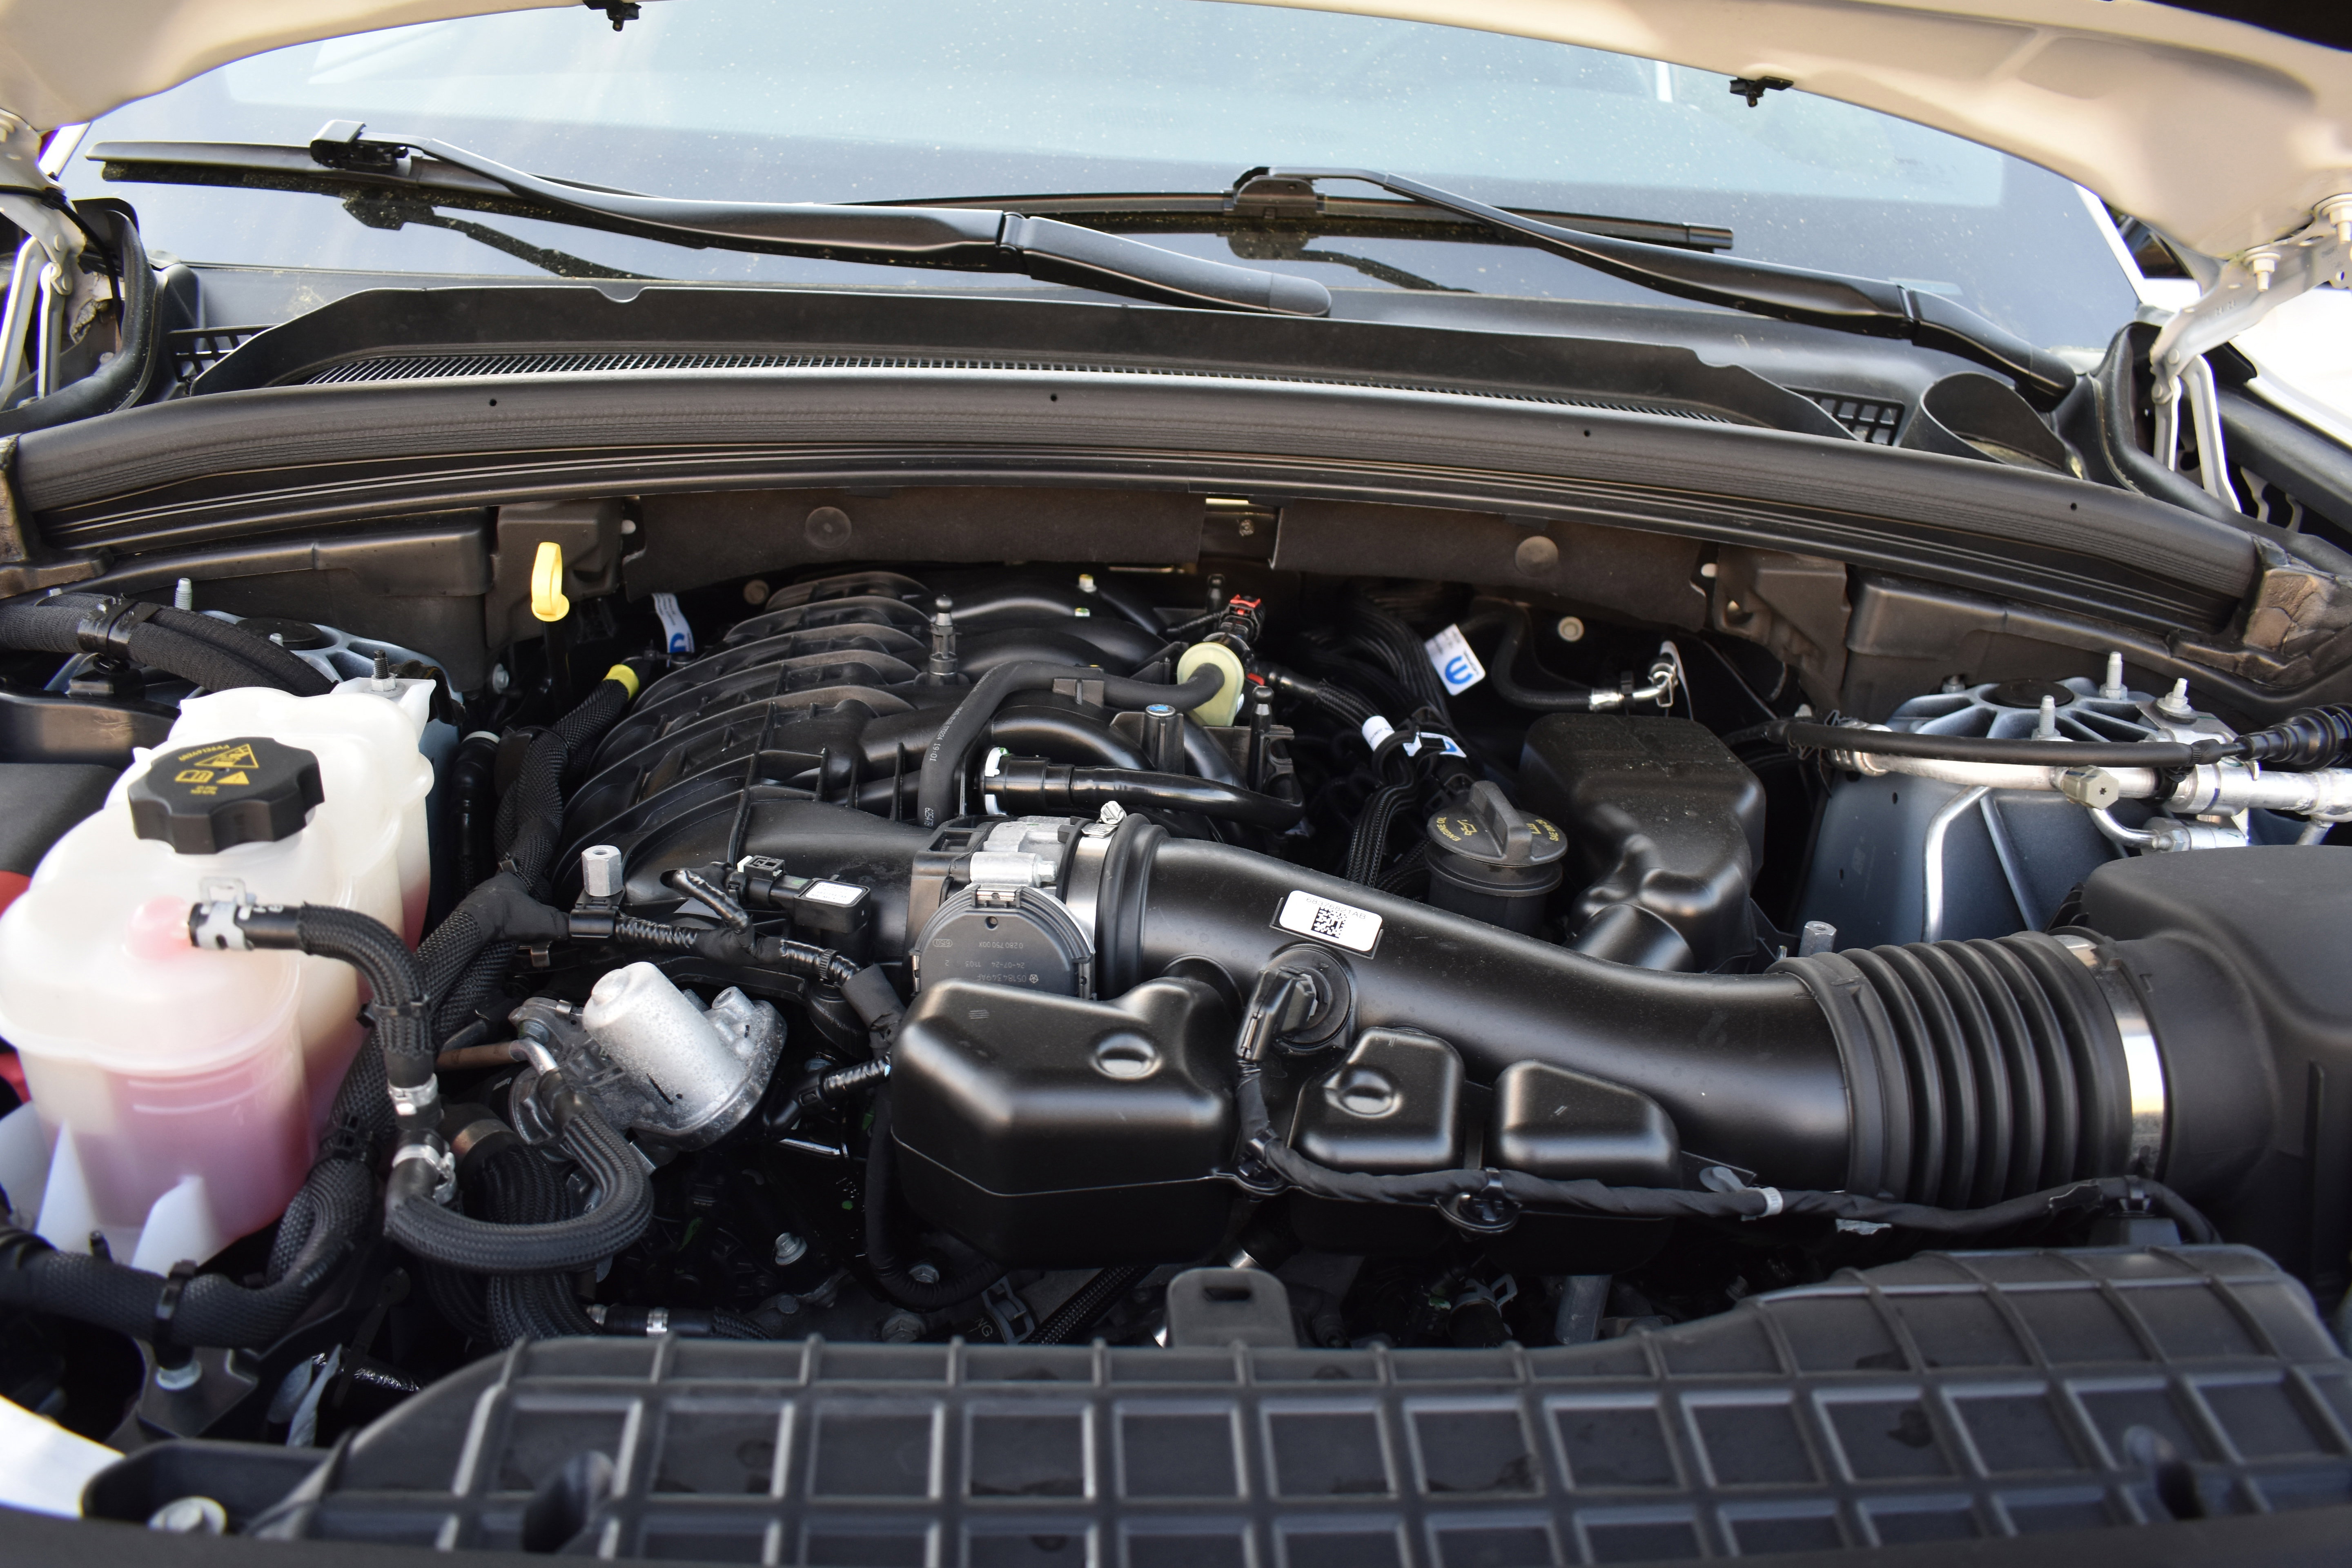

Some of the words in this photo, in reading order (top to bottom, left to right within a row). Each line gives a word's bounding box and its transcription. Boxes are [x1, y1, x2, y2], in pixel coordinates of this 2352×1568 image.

[929, 743, 941, 762] 19:01
[1437, 824, 1462, 842] ENGINE
[1548, 832, 1560, 842] SAE
[1306, 897, 1366, 920] 68376821AB
[976, 973, 1027, 982] 05184349AF
